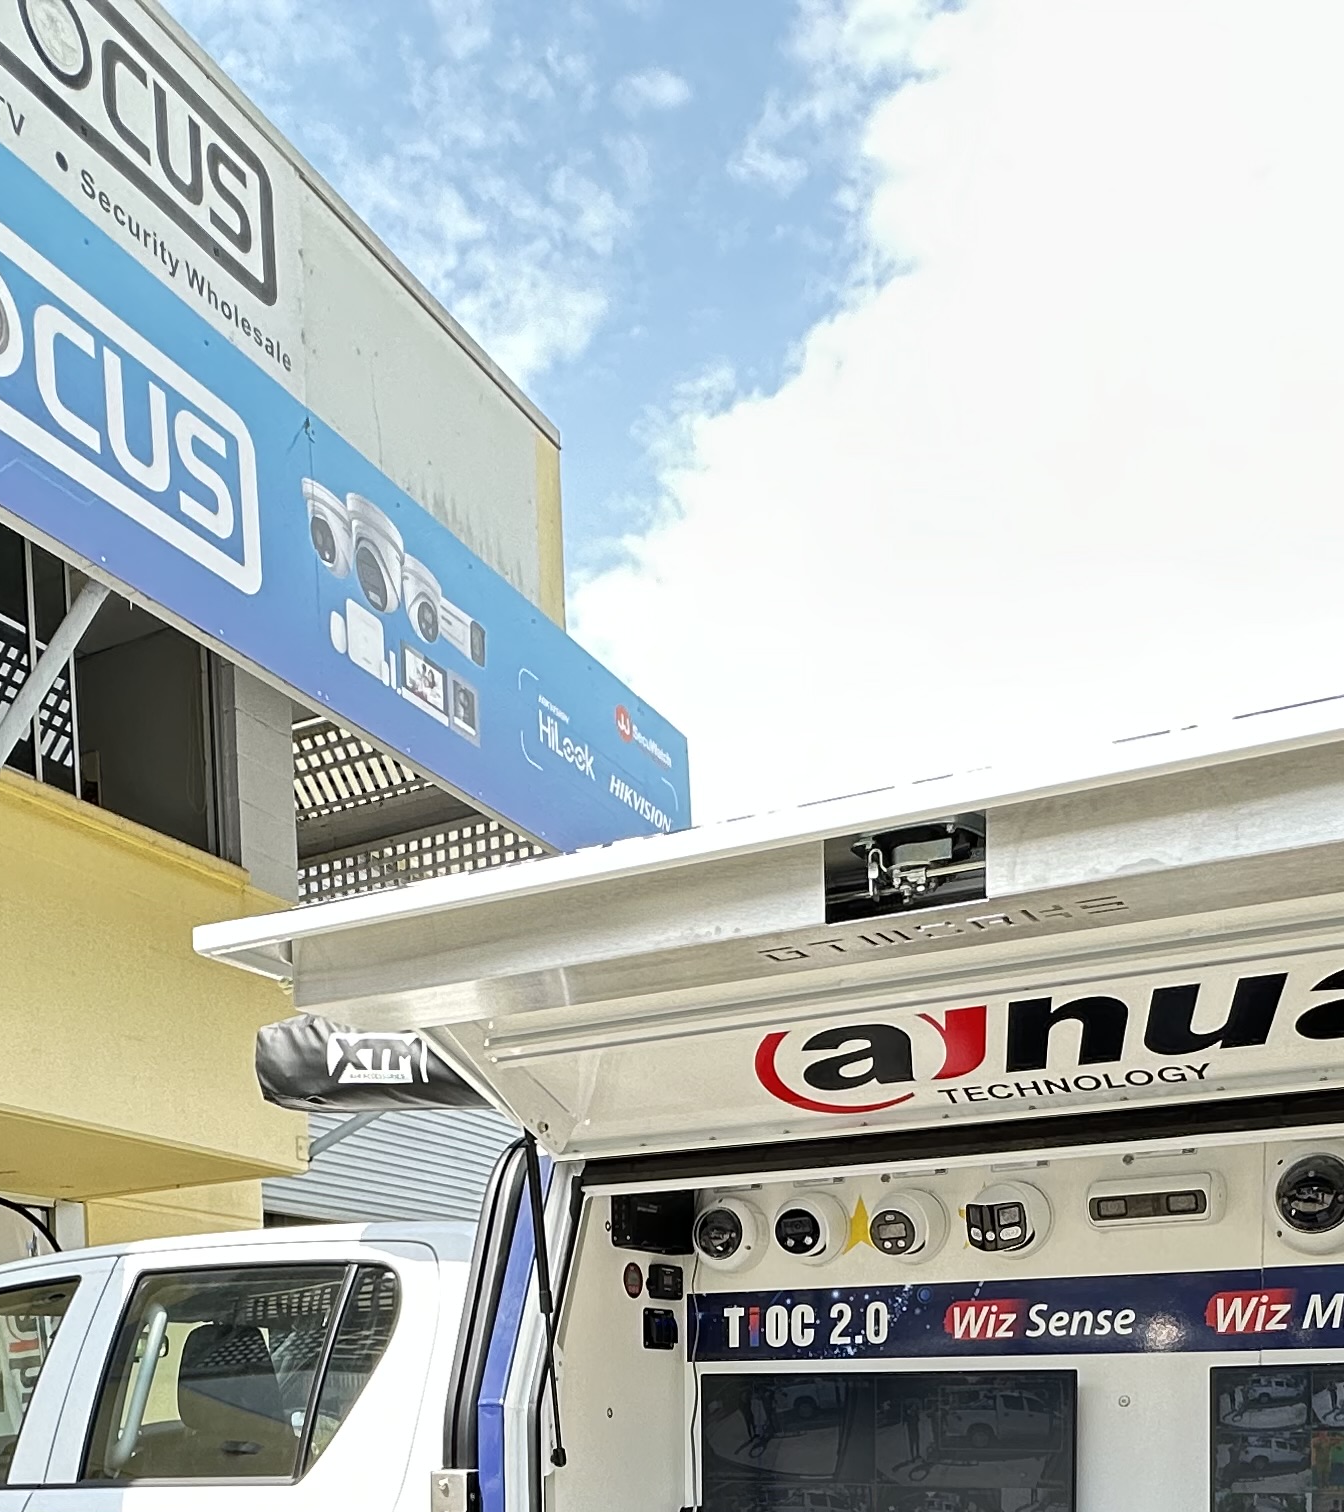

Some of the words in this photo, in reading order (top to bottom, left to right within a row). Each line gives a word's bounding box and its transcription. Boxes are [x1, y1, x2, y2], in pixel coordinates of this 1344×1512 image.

[80, 169, 179, 279] Security
[184, 262, 293, 373] Wholesale
[538, 709, 597, 782] HiLook
[609, 774, 673, 833] HIKVISION
[937, 1061, 1212, 1105] TECHNOLOGY
[829, 1300, 890, 1346] 2.0
[951, 1305, 1018, 1340] Wiz
[1026, 1302, 1138, 1339] Sense
[1213, 1295, 1295, 1334] Wiz
